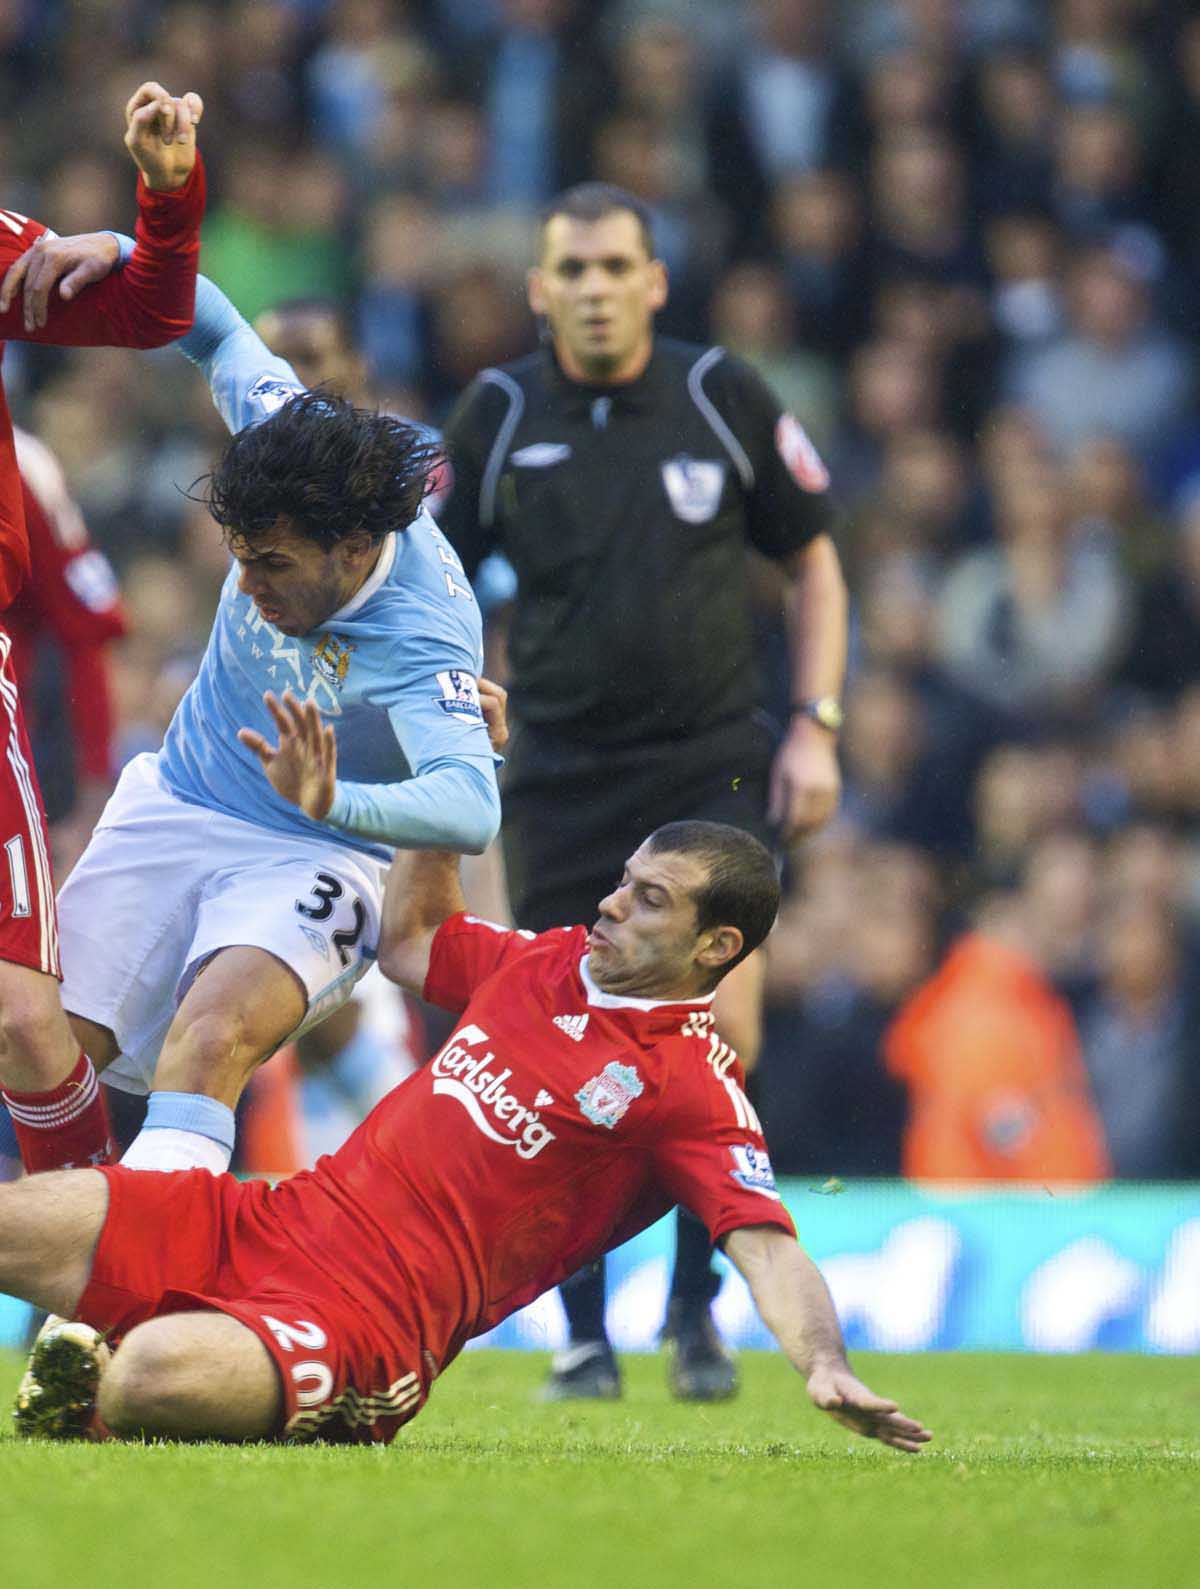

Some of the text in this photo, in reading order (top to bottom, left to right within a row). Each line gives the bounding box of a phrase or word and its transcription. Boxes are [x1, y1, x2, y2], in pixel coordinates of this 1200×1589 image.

[294, 871, 367, 969] 32
[431, 1023, 557, 1160] Carlsberg
[259, 1314, 334, 1407] 20
